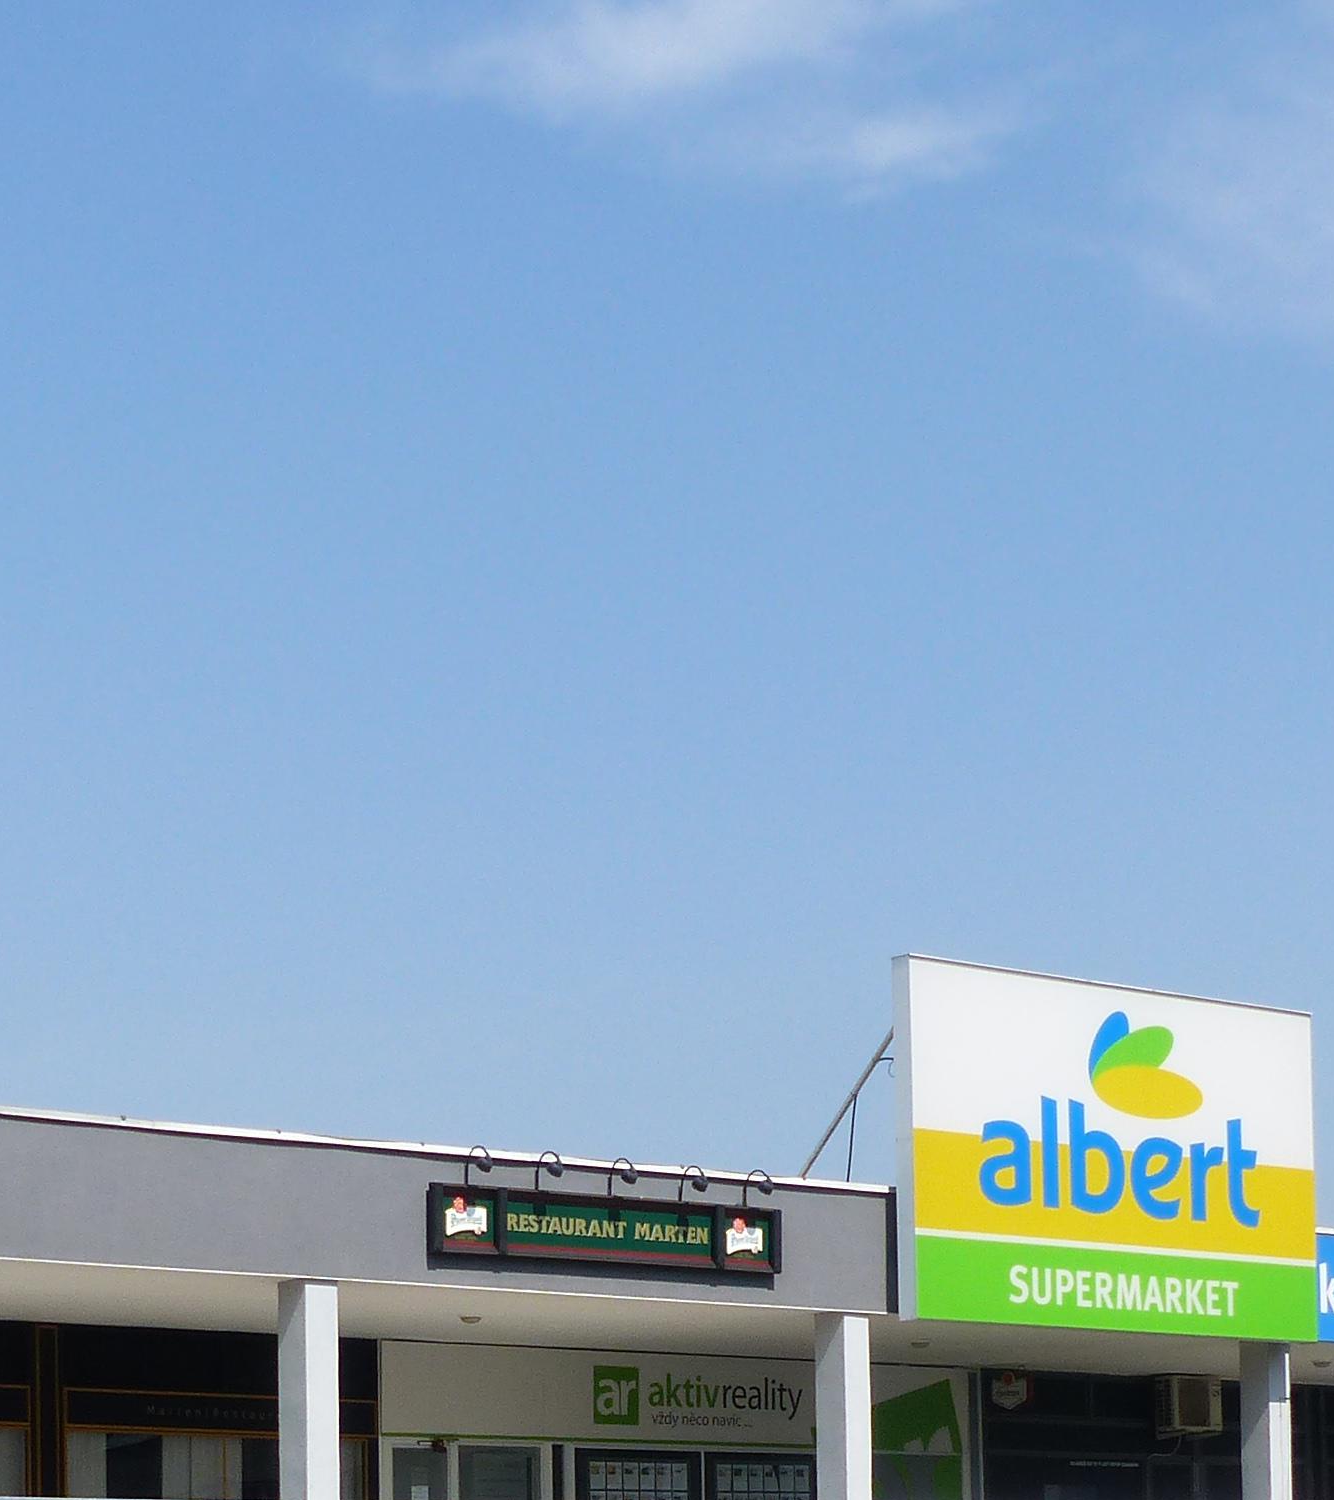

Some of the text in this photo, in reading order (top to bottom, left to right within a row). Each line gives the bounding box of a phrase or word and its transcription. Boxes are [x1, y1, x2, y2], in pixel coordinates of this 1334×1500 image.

[978, 1095, 1261, 1229] albert
[507, 1213, 627, 1239] RESTAURANT
[634, 1222, 709, 1245] MARTEN
[1009, 1264, 1239, 1317] SUPERMARKET
[596, 1373, 803, 1421] ar aktivreality
[651, 1413, 679, 1429] vždy
[682, 1414, 709, 1426] něco
